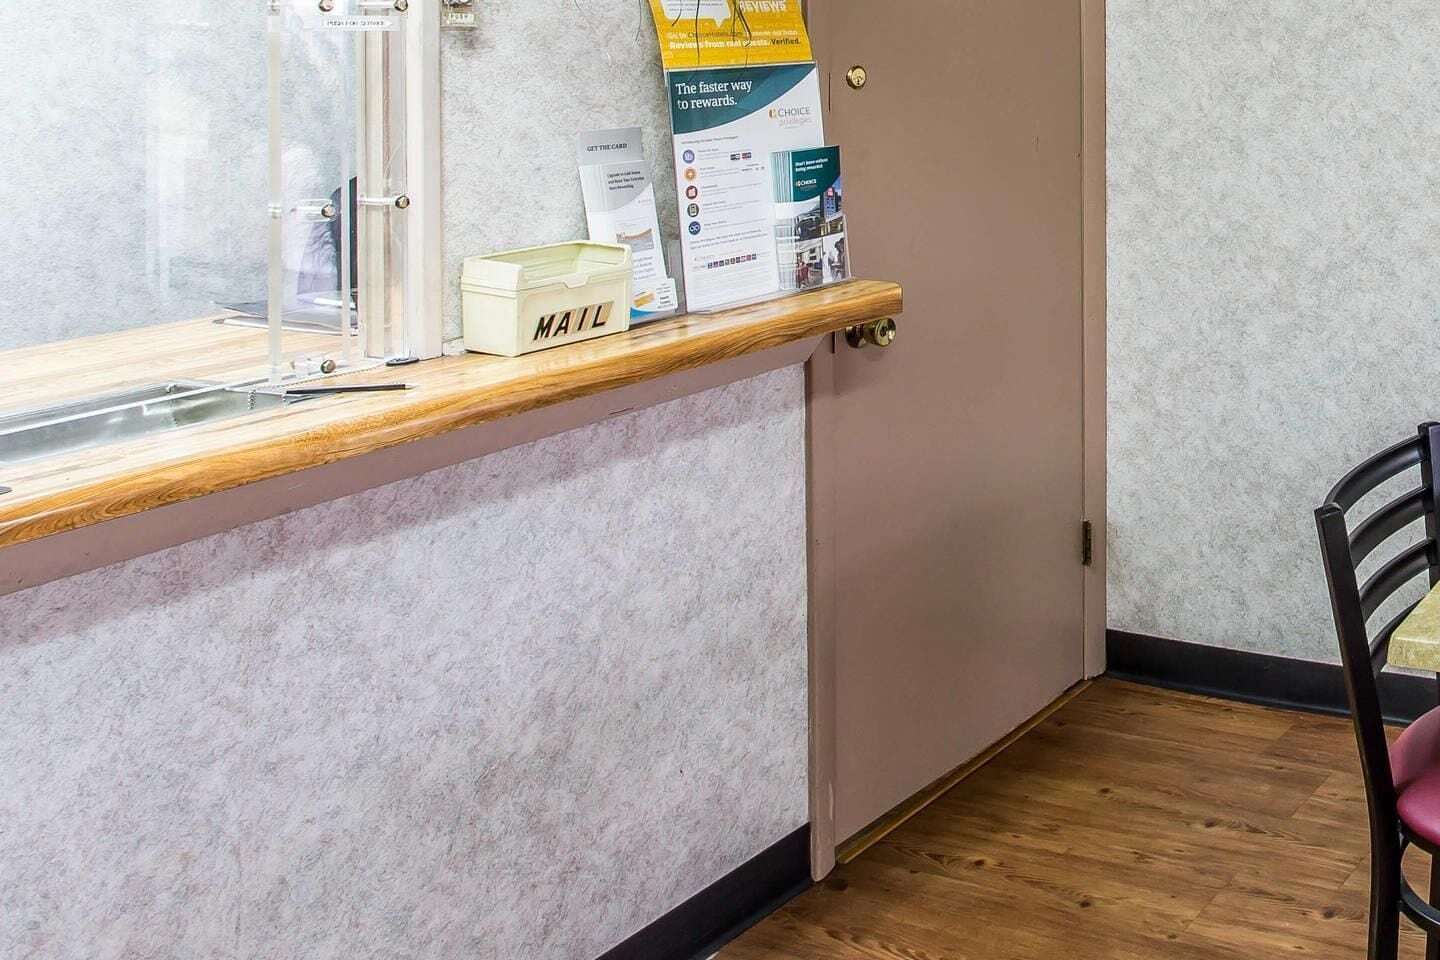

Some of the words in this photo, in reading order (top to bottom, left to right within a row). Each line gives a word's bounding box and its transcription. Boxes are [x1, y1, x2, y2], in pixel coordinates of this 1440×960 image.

[739, 0, 787, 12] REVIEWS
[669, 41, 704, 49] Reviews
[705, 40, 725, 48] from
[726, 40, 742, 48] real
[675, 82, 697, 95] The
[700, 81, 729, 93] faster
[731, 80, 752, 93] way
[677, 99, 689, 110] to
[691, 95, 738, 109] rewards.
[778, 106, 811, 117] CHOICE
[532, 304, 607, 341] MAIL
